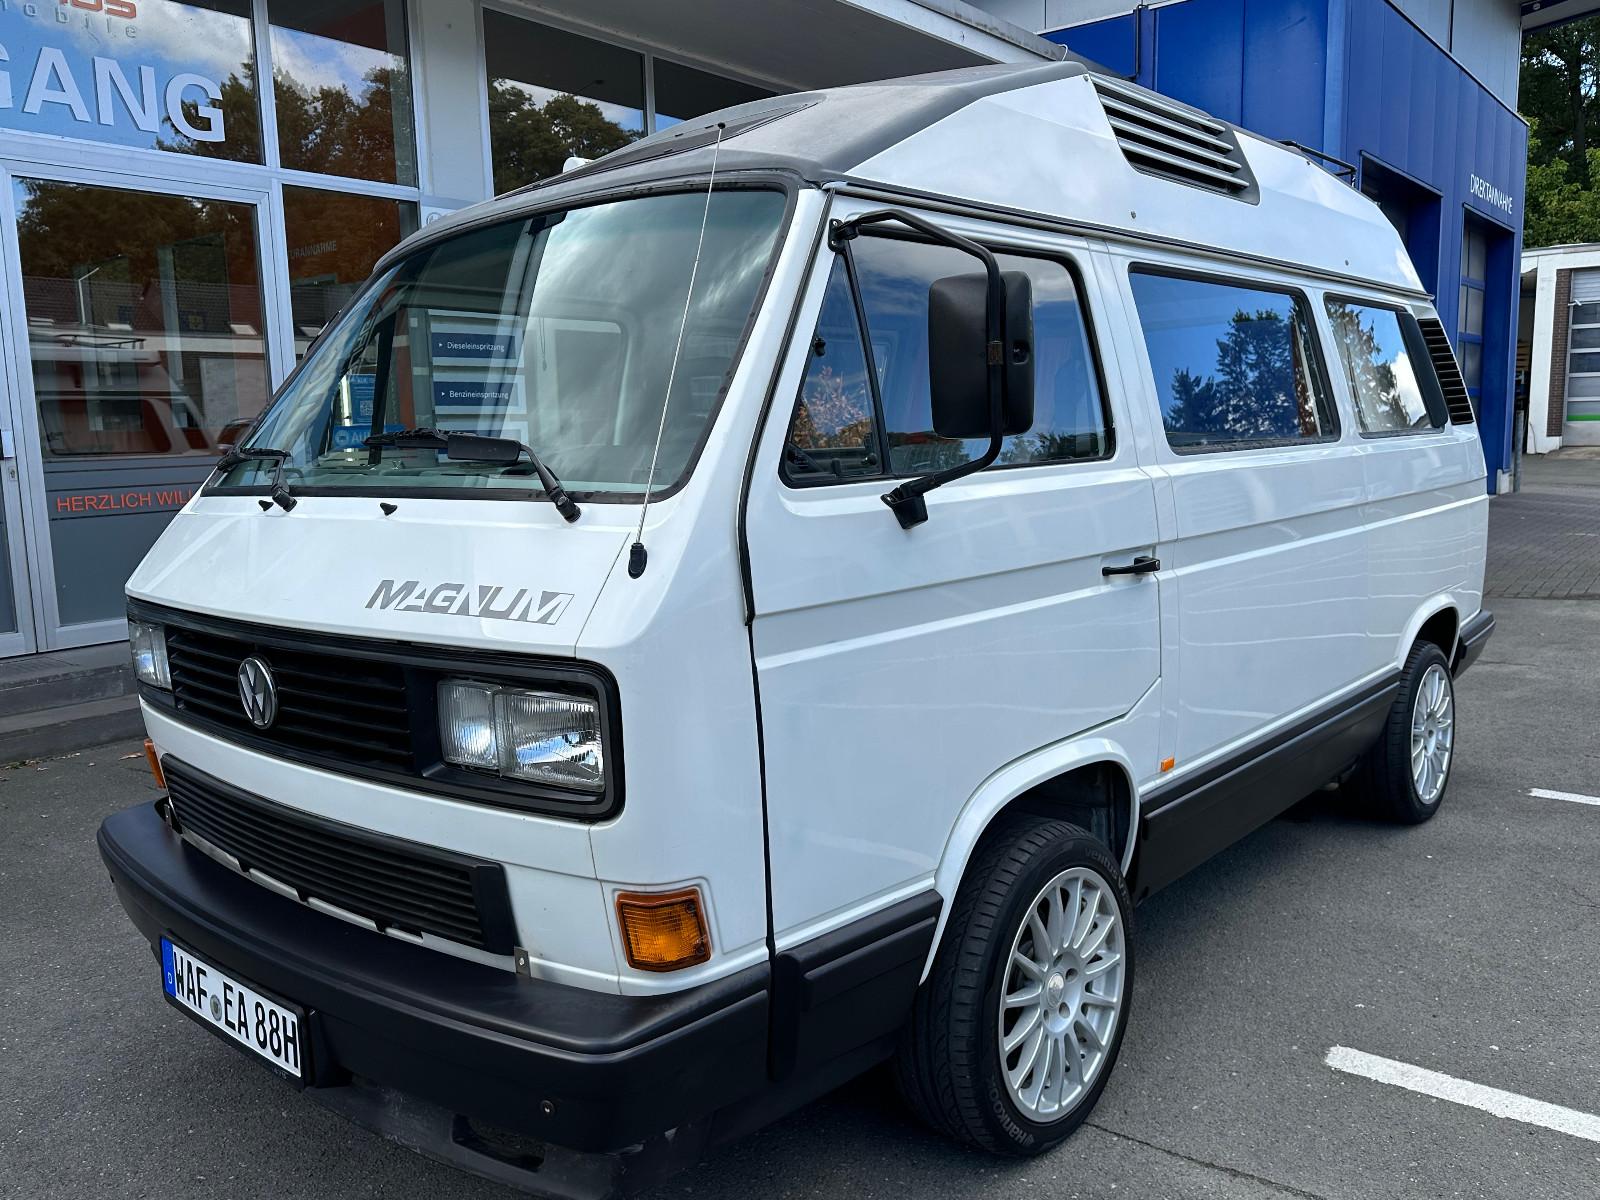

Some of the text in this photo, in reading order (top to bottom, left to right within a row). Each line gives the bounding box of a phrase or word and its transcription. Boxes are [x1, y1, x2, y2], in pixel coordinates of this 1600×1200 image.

[0, 1, 137, 38] obile
[0, 43, 225, 142] ANG
[447, 341, 505, 352] Dieseleinspritzung
[449, 390, 509, 400] Benzineinspritzung
[57, 492, 152, 512] HERZLICH
[365, 580, 574, 625] MAGNUM
[174, 951, 299, 1069] WAF EA 88H
